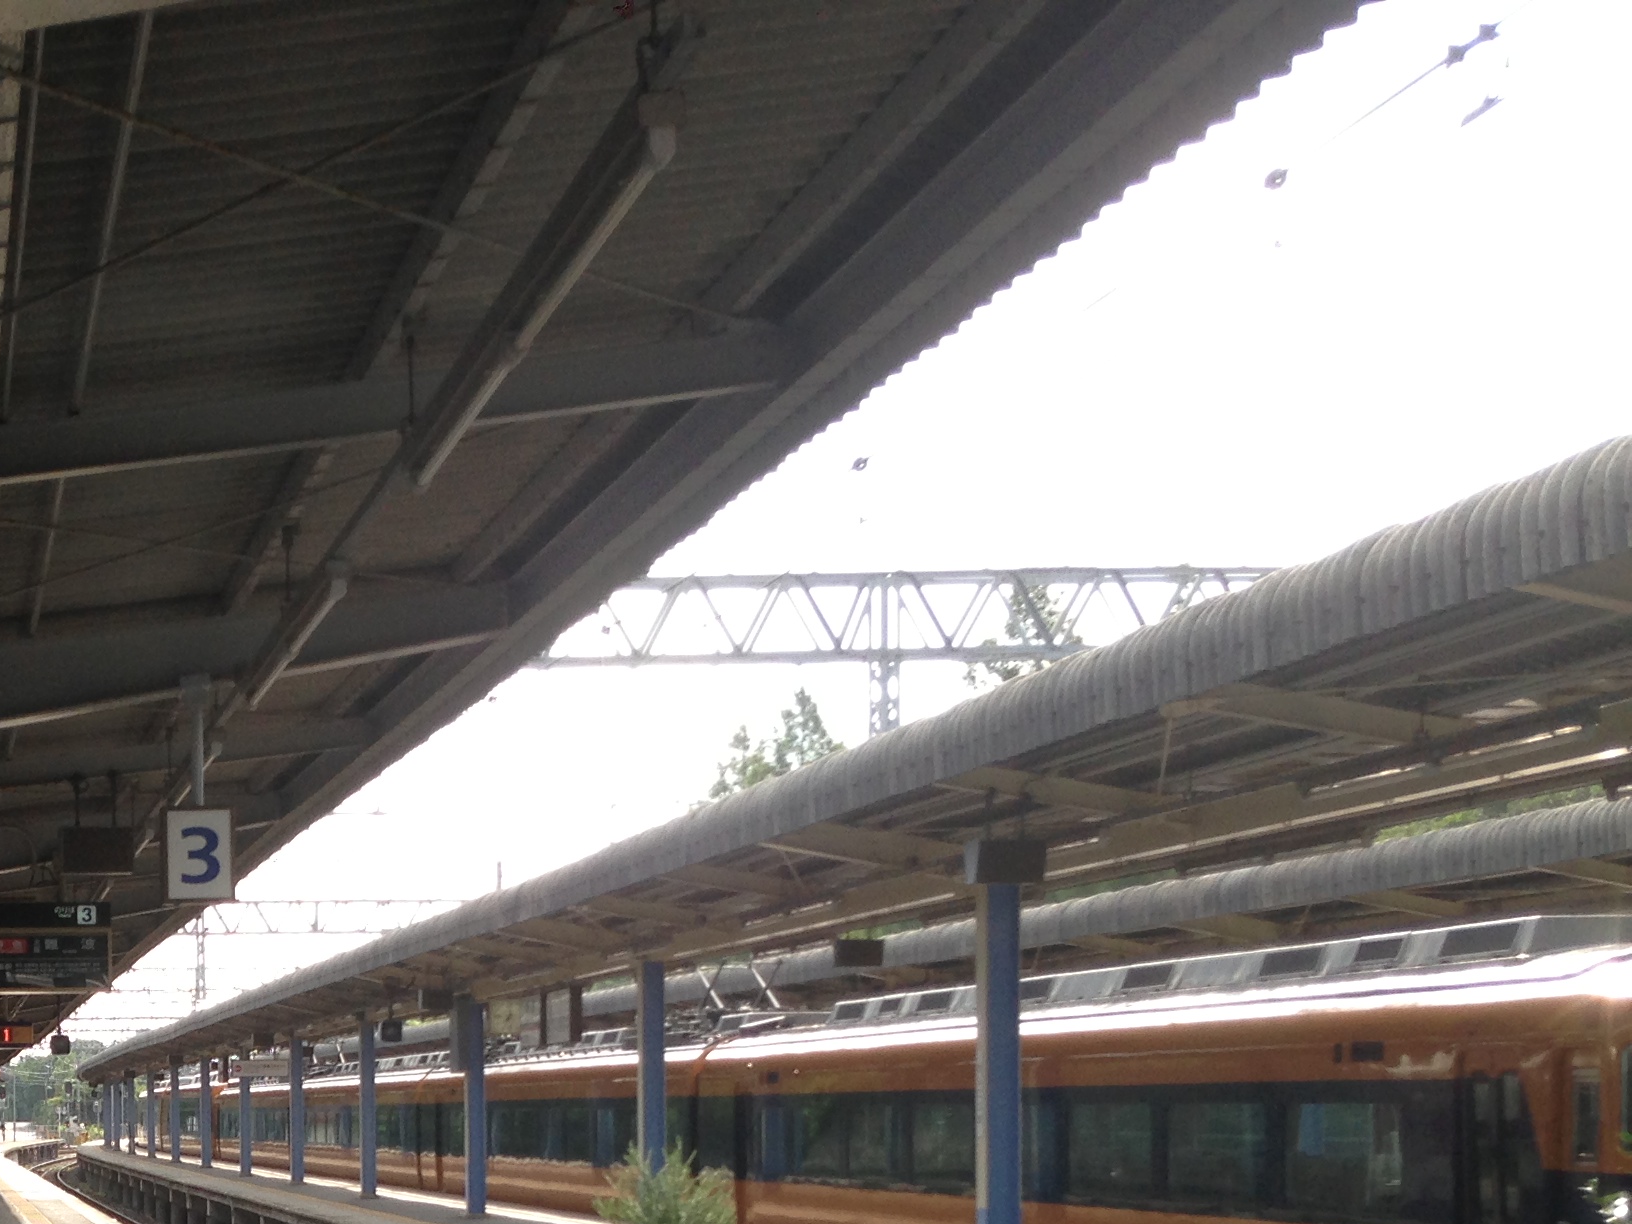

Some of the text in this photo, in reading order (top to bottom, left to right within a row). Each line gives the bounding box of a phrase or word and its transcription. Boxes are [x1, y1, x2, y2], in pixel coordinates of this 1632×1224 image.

[180, 826, 221, 885] 3
[81, 907, 92, 922] 3
[3, 1028, 10, 1042] 1
